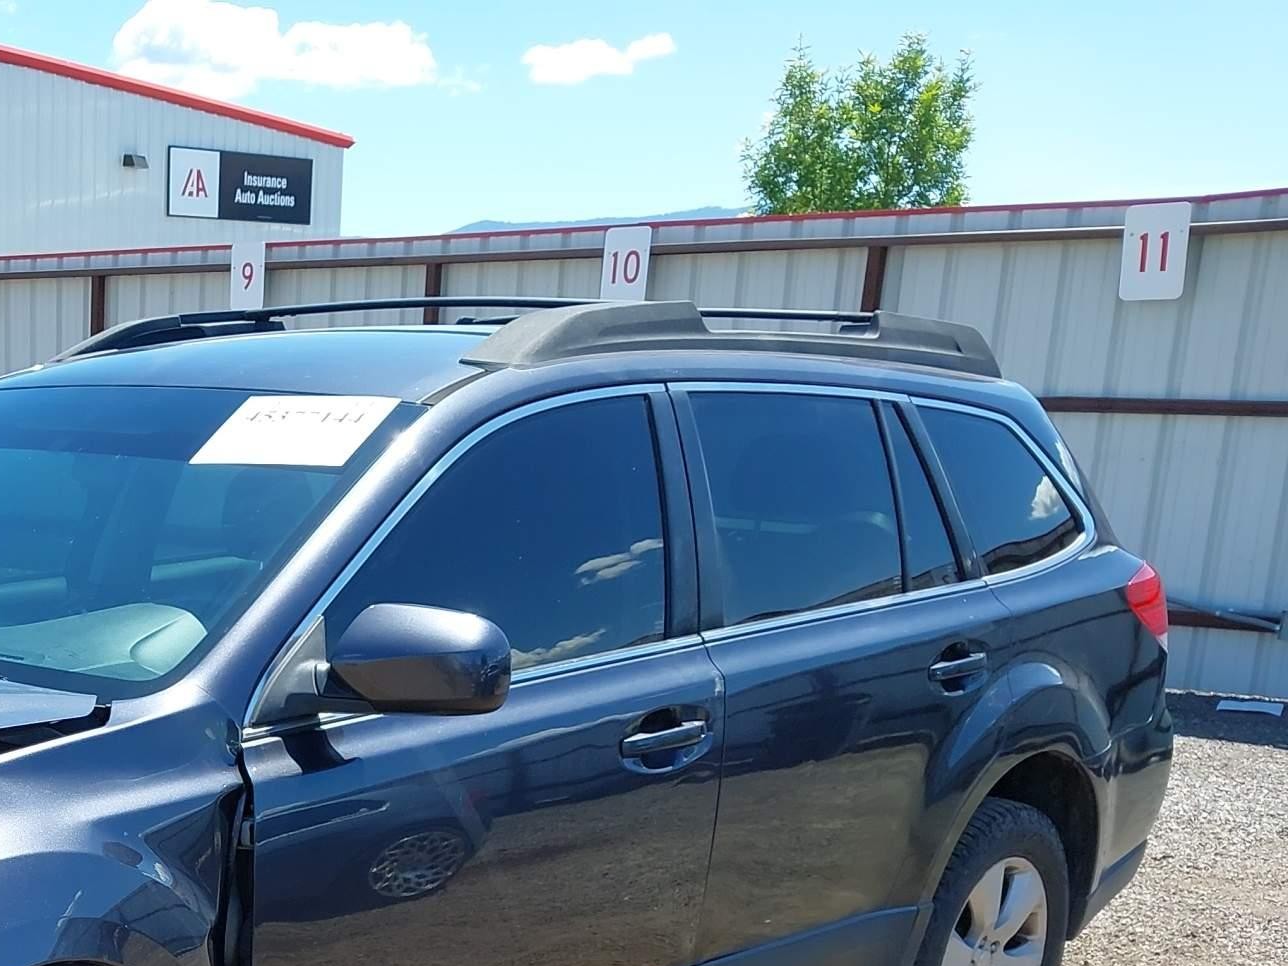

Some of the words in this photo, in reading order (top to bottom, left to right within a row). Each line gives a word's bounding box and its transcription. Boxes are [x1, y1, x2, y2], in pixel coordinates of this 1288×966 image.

[243, 171, 287, 189] Insurance
[235, 190, 256, 205] Auto
[258, 191, 295, 207] Auctions
[1139, 231, 1170, 272] 11
[242, 262, 253, 290] 9
[611, 249, 641, 284] 10
